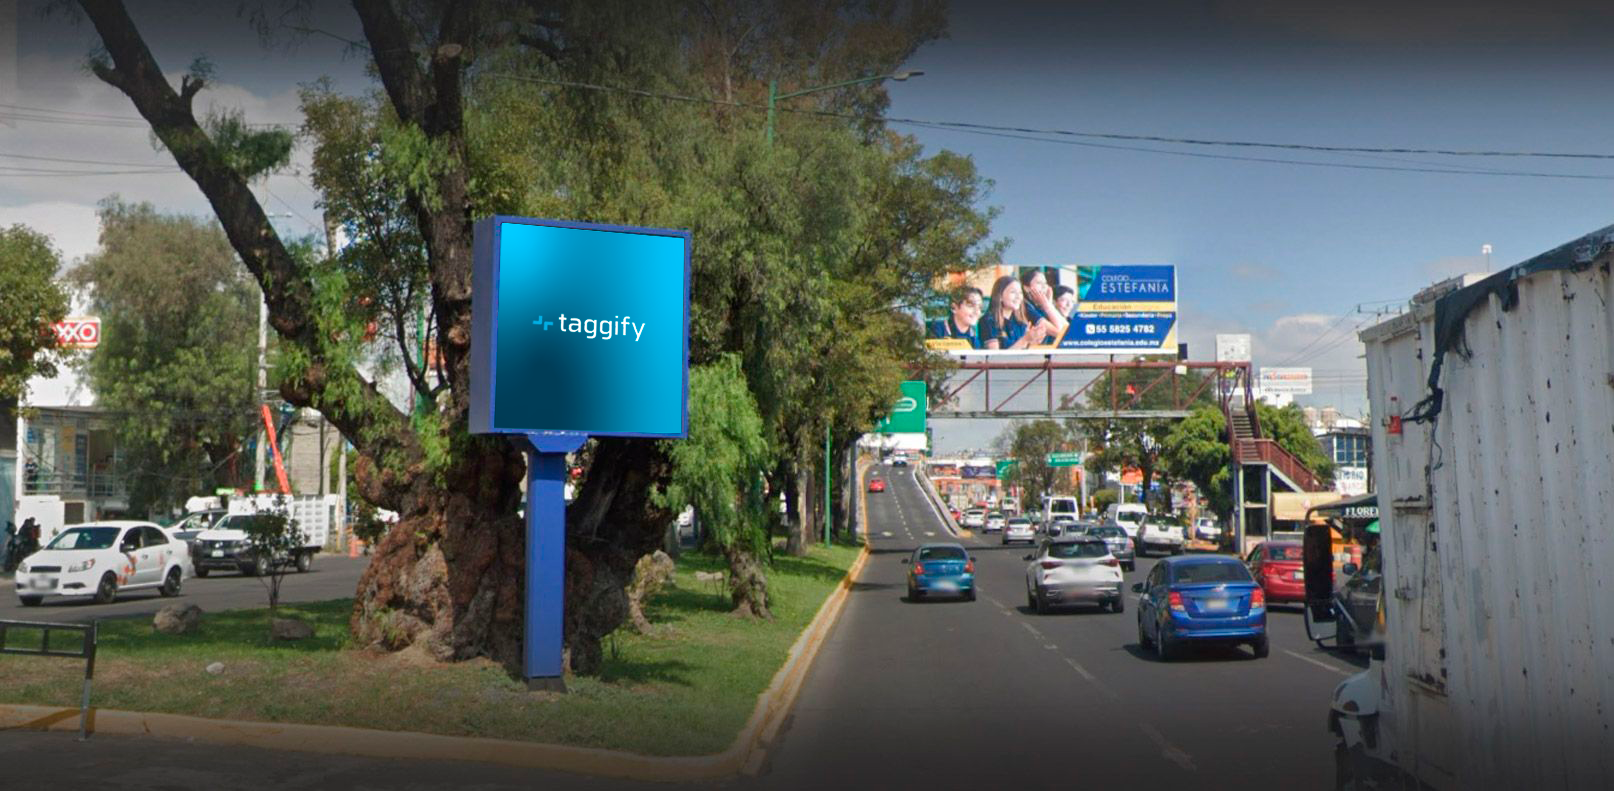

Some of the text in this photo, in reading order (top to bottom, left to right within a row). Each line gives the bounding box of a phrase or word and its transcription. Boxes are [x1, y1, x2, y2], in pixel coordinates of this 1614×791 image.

[55, 322, 97, 342] XXO
[558, 313, 646, 342] taggify
[1096, 325, 1107, 333] 55
[1110, 325, 1131, 333] 5825
